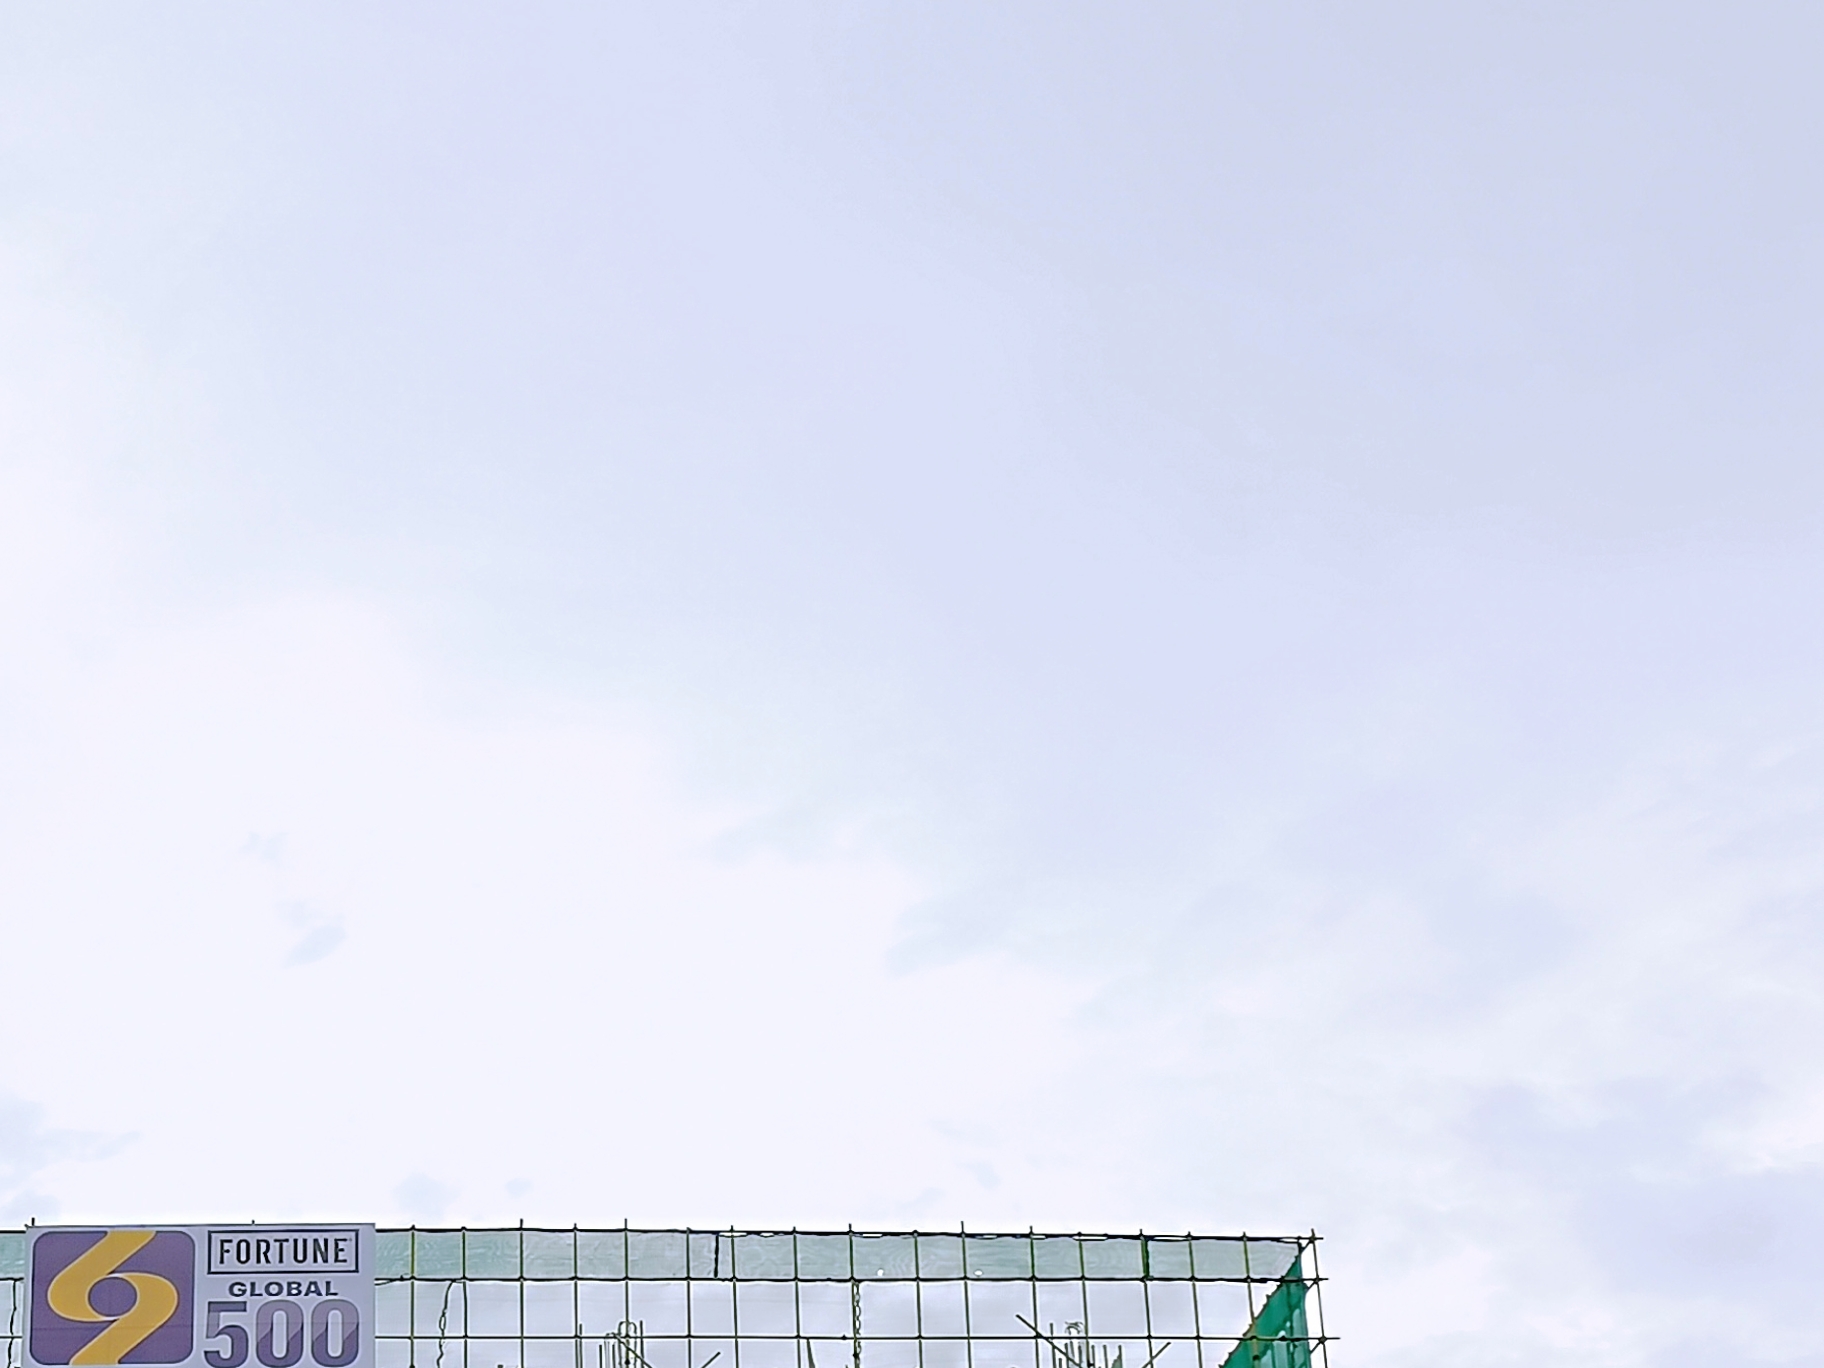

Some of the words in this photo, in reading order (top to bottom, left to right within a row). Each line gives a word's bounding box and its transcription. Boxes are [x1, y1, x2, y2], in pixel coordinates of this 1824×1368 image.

[219, 1238, 349, 1265] FORTUNE
[228, 1281, 339, 1297] GLOBAL
[204, 1299, 360, 1368] 500
